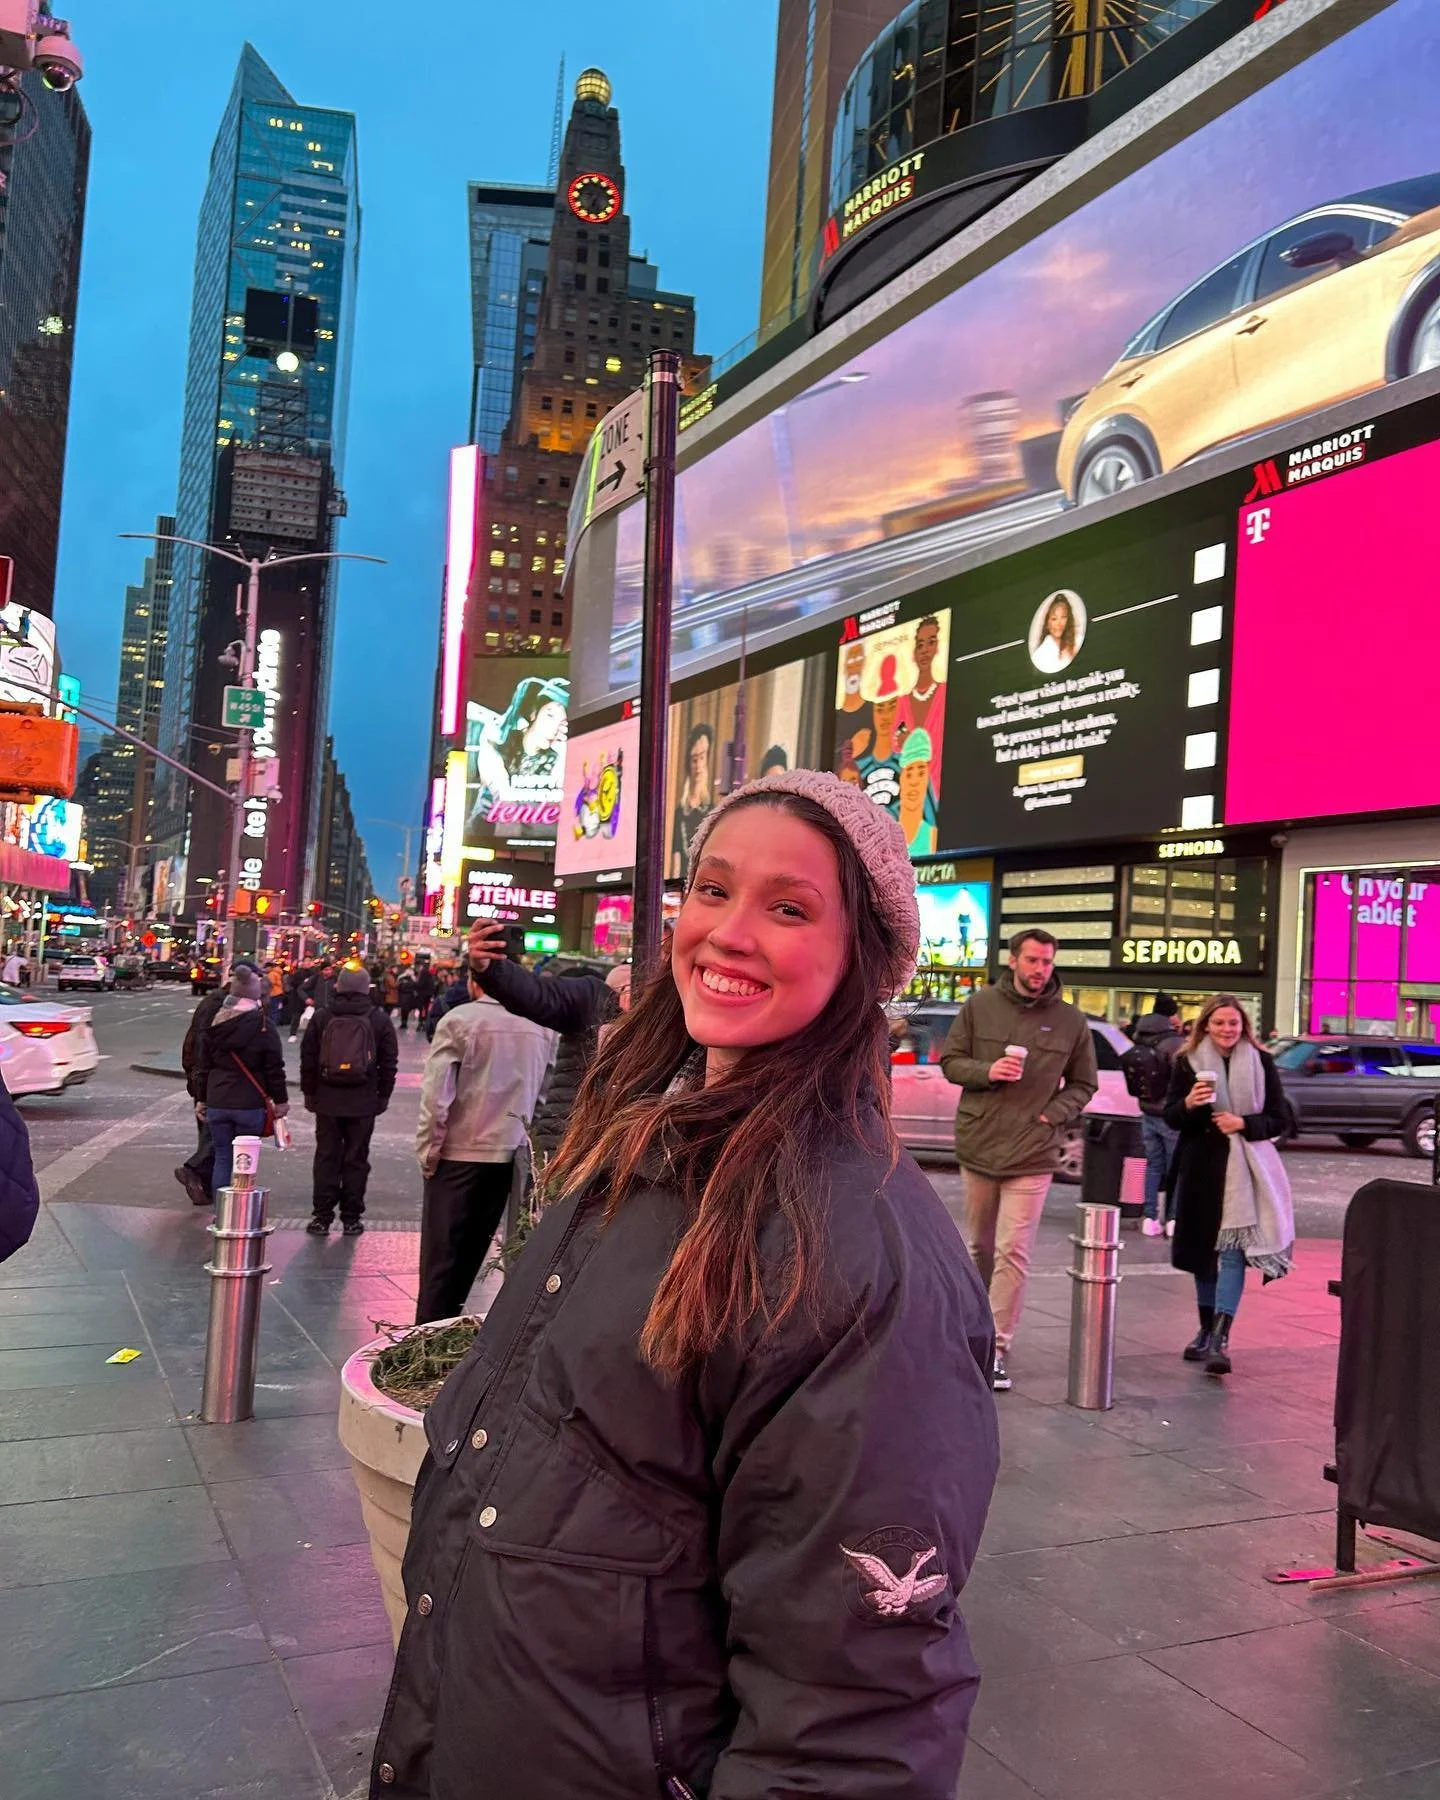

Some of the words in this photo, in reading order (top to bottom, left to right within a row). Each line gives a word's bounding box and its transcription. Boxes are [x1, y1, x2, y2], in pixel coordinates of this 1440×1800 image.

[844, 152, 925, 217] MARRIOTT
[842, 181, 912, 238] MARQUIS
[1288, 424, 1375, 467] MARRIOTT
[1287, 446, 1363, 483] MARQUIS
[1158, 839, 1225, 858] SEPHORA
[468, 885, 557, 910] #TENLEE
[1347, 902, 1417, 929] ablet
[1122, 939, 1242, 965] SEPHORA
